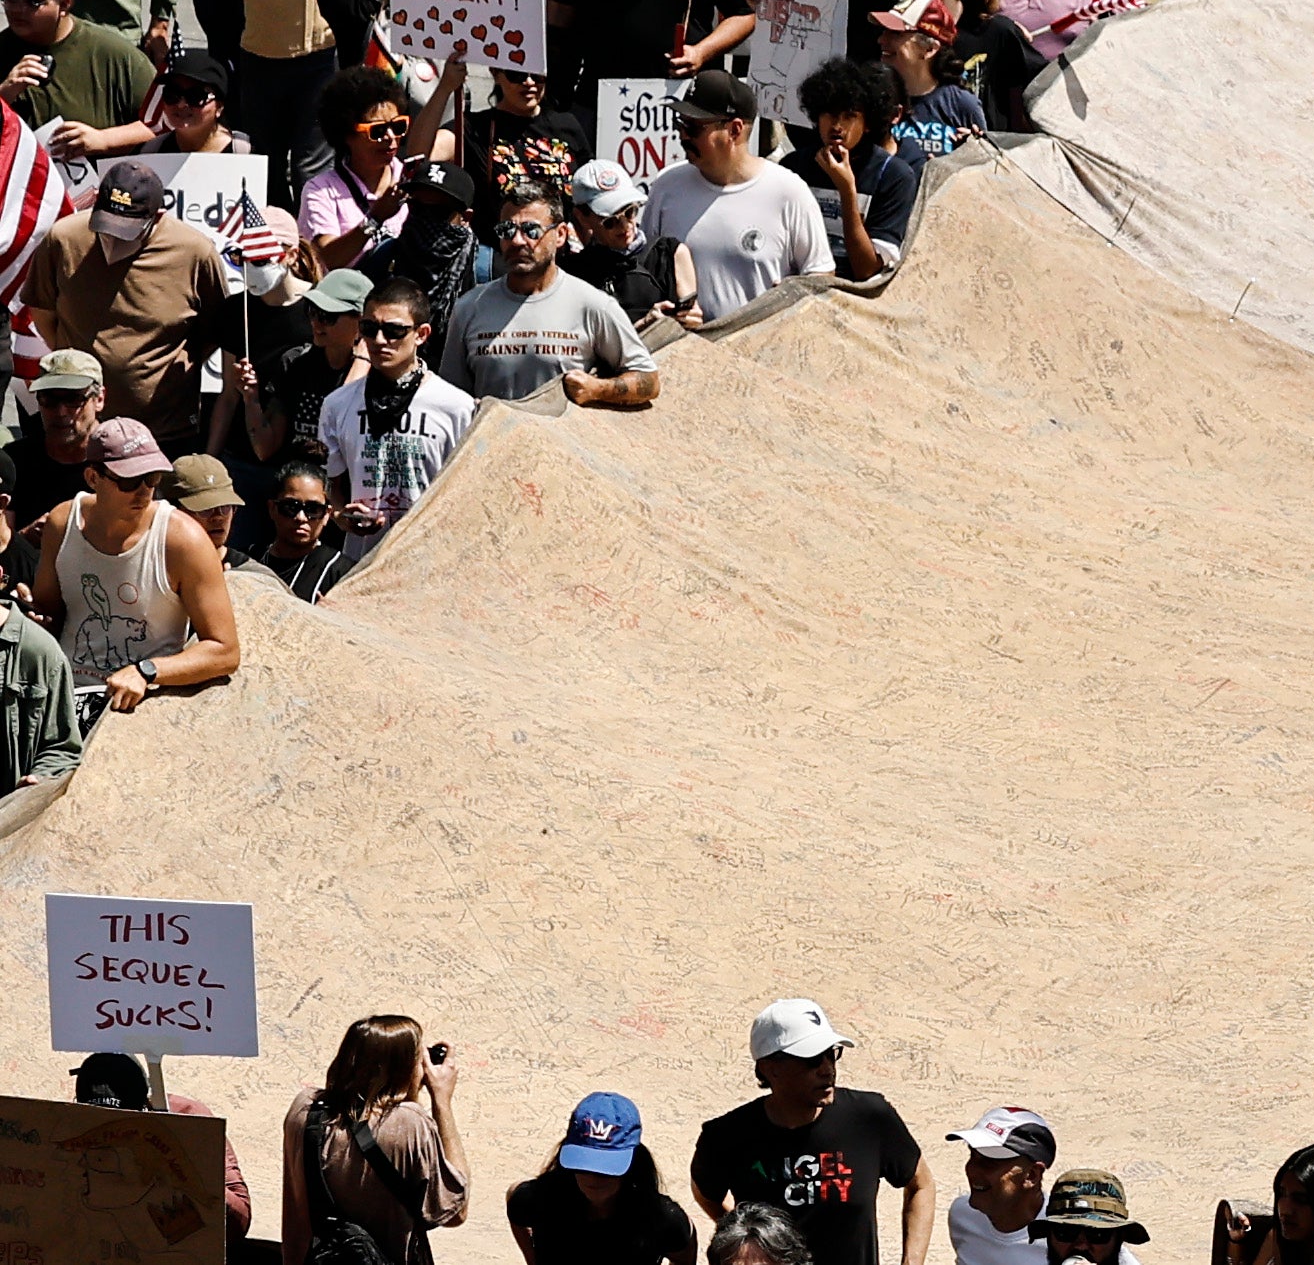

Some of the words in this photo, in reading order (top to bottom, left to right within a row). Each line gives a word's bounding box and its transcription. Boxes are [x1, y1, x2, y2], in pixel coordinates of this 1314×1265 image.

[476, 344, 528, 355] AGAINST
[534, 344, 578, 356] TRUMP
[101, 912, 190, 944] THIS
[75, 953, 224, 989] SEQUEL
[95, 997, 212, 1031] SUCKS!
[784, 1177, 852, 1206] CITY
